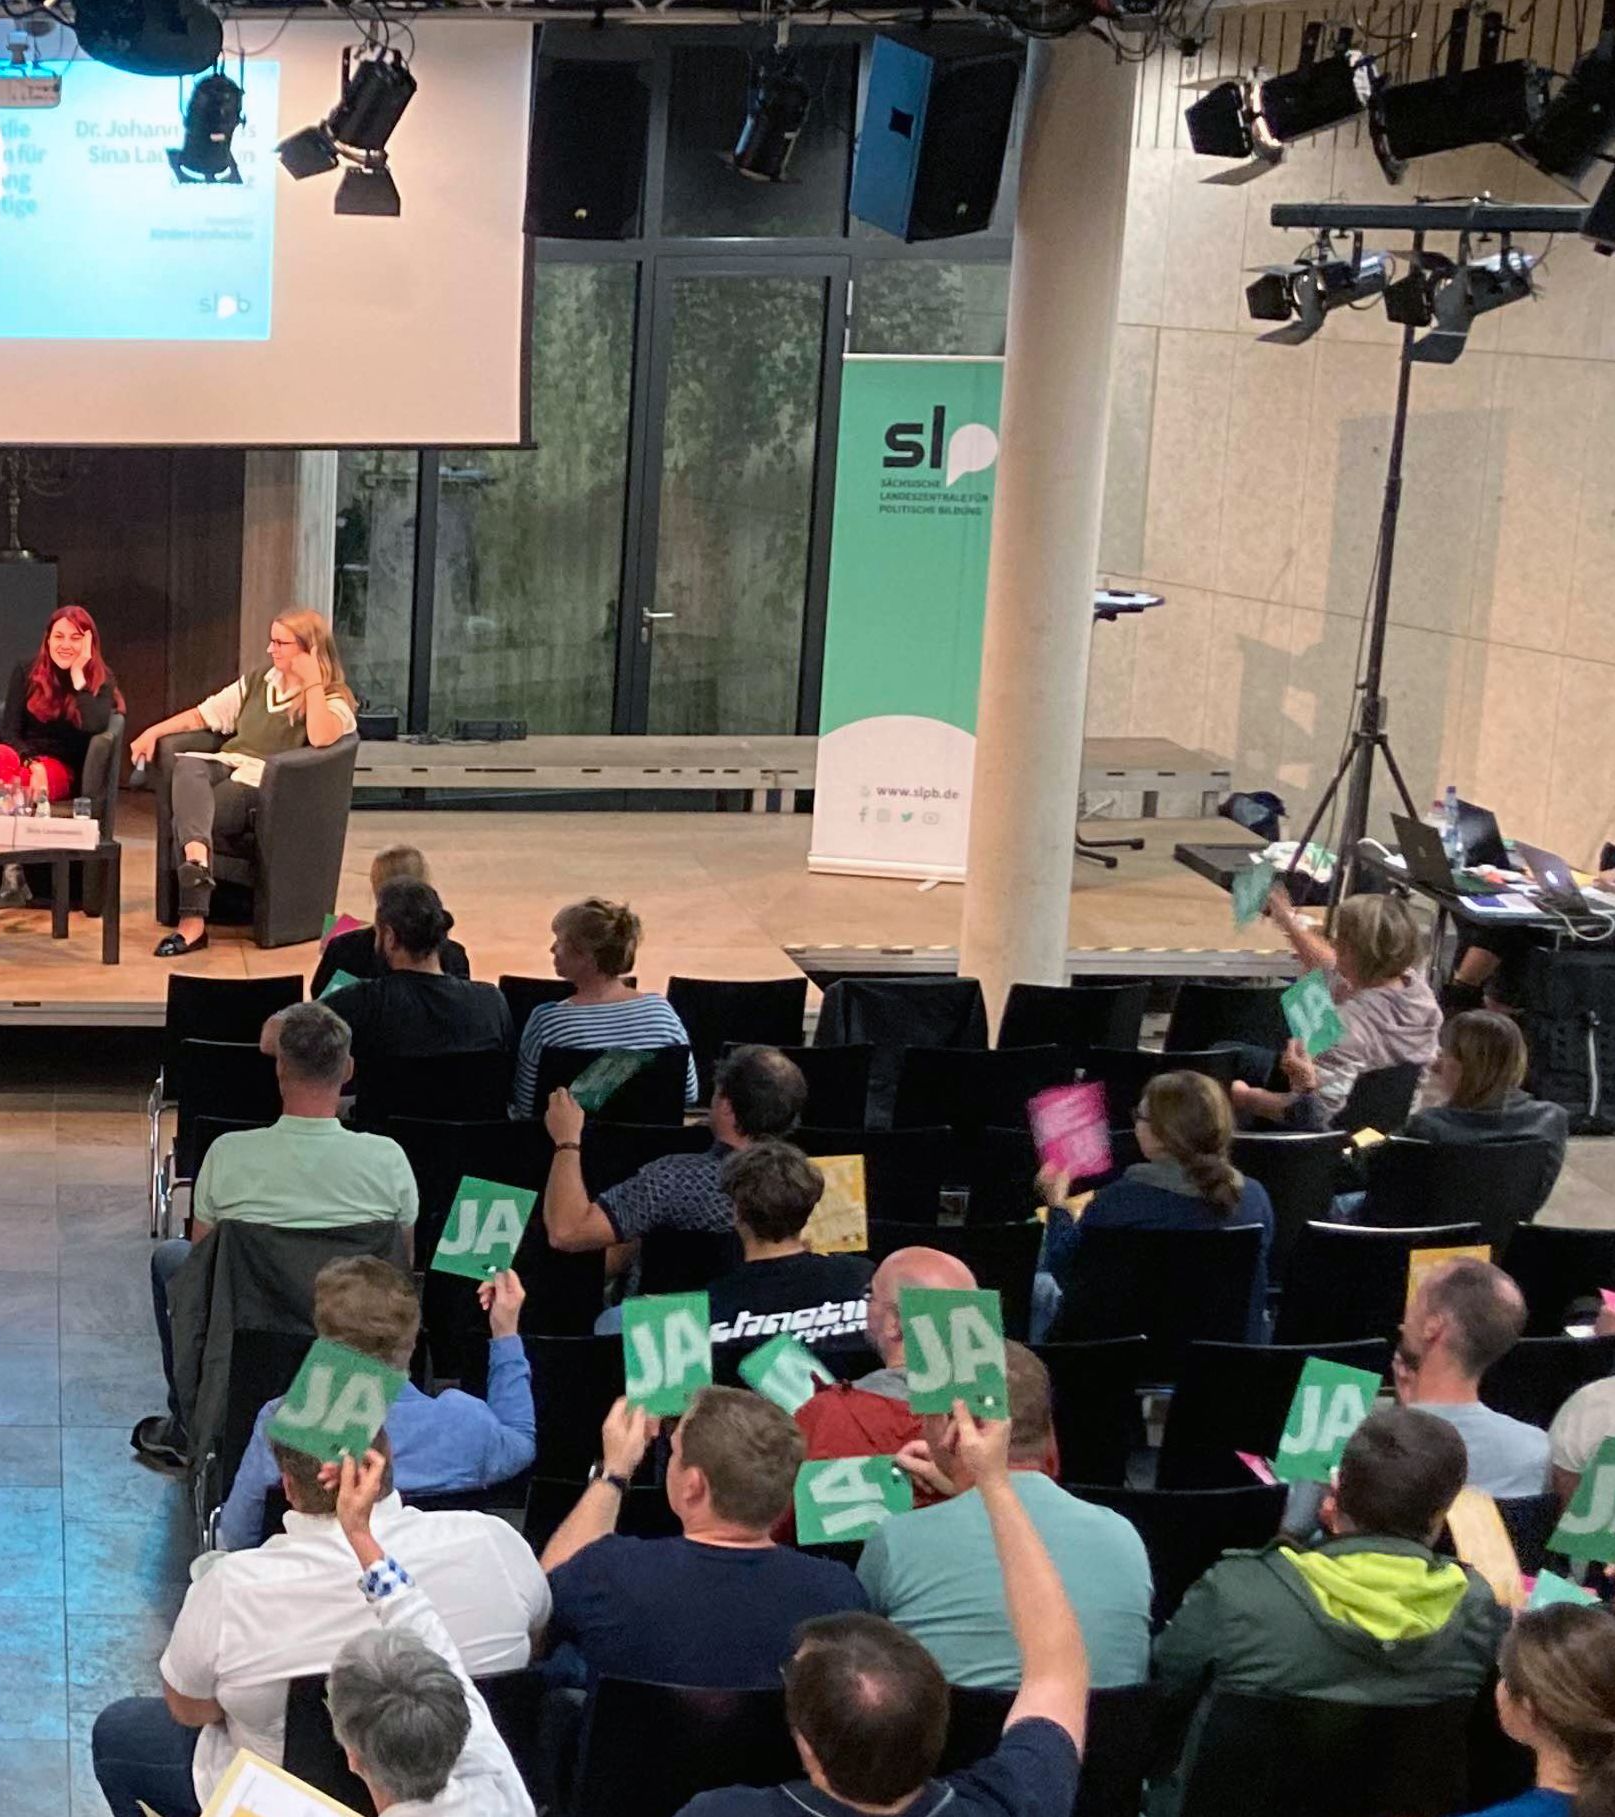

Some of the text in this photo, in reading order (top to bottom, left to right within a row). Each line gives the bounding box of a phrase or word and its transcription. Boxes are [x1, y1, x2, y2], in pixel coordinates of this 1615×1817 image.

[75, 119, 181, 138] Dr. Johann
[879, 505, 981, 516] POLITISCHE BILDUNG
[880, 492, 988, 503] LANDESZENTRALE FÜR
[881, 478, 941, 488] SÄCHSISCHE
[877, 786, 959, 801] www.slpb.de
[437, 1198, 526, 1256] JA
[626, 1309, 712, 1396] JA
[906, 1305, 1007, 1393] JA
[279, 1364, 384, 1434] JA
[1278, 1383, 1368, 1454] JA
[1557, 1464, 1615, 1535] J
